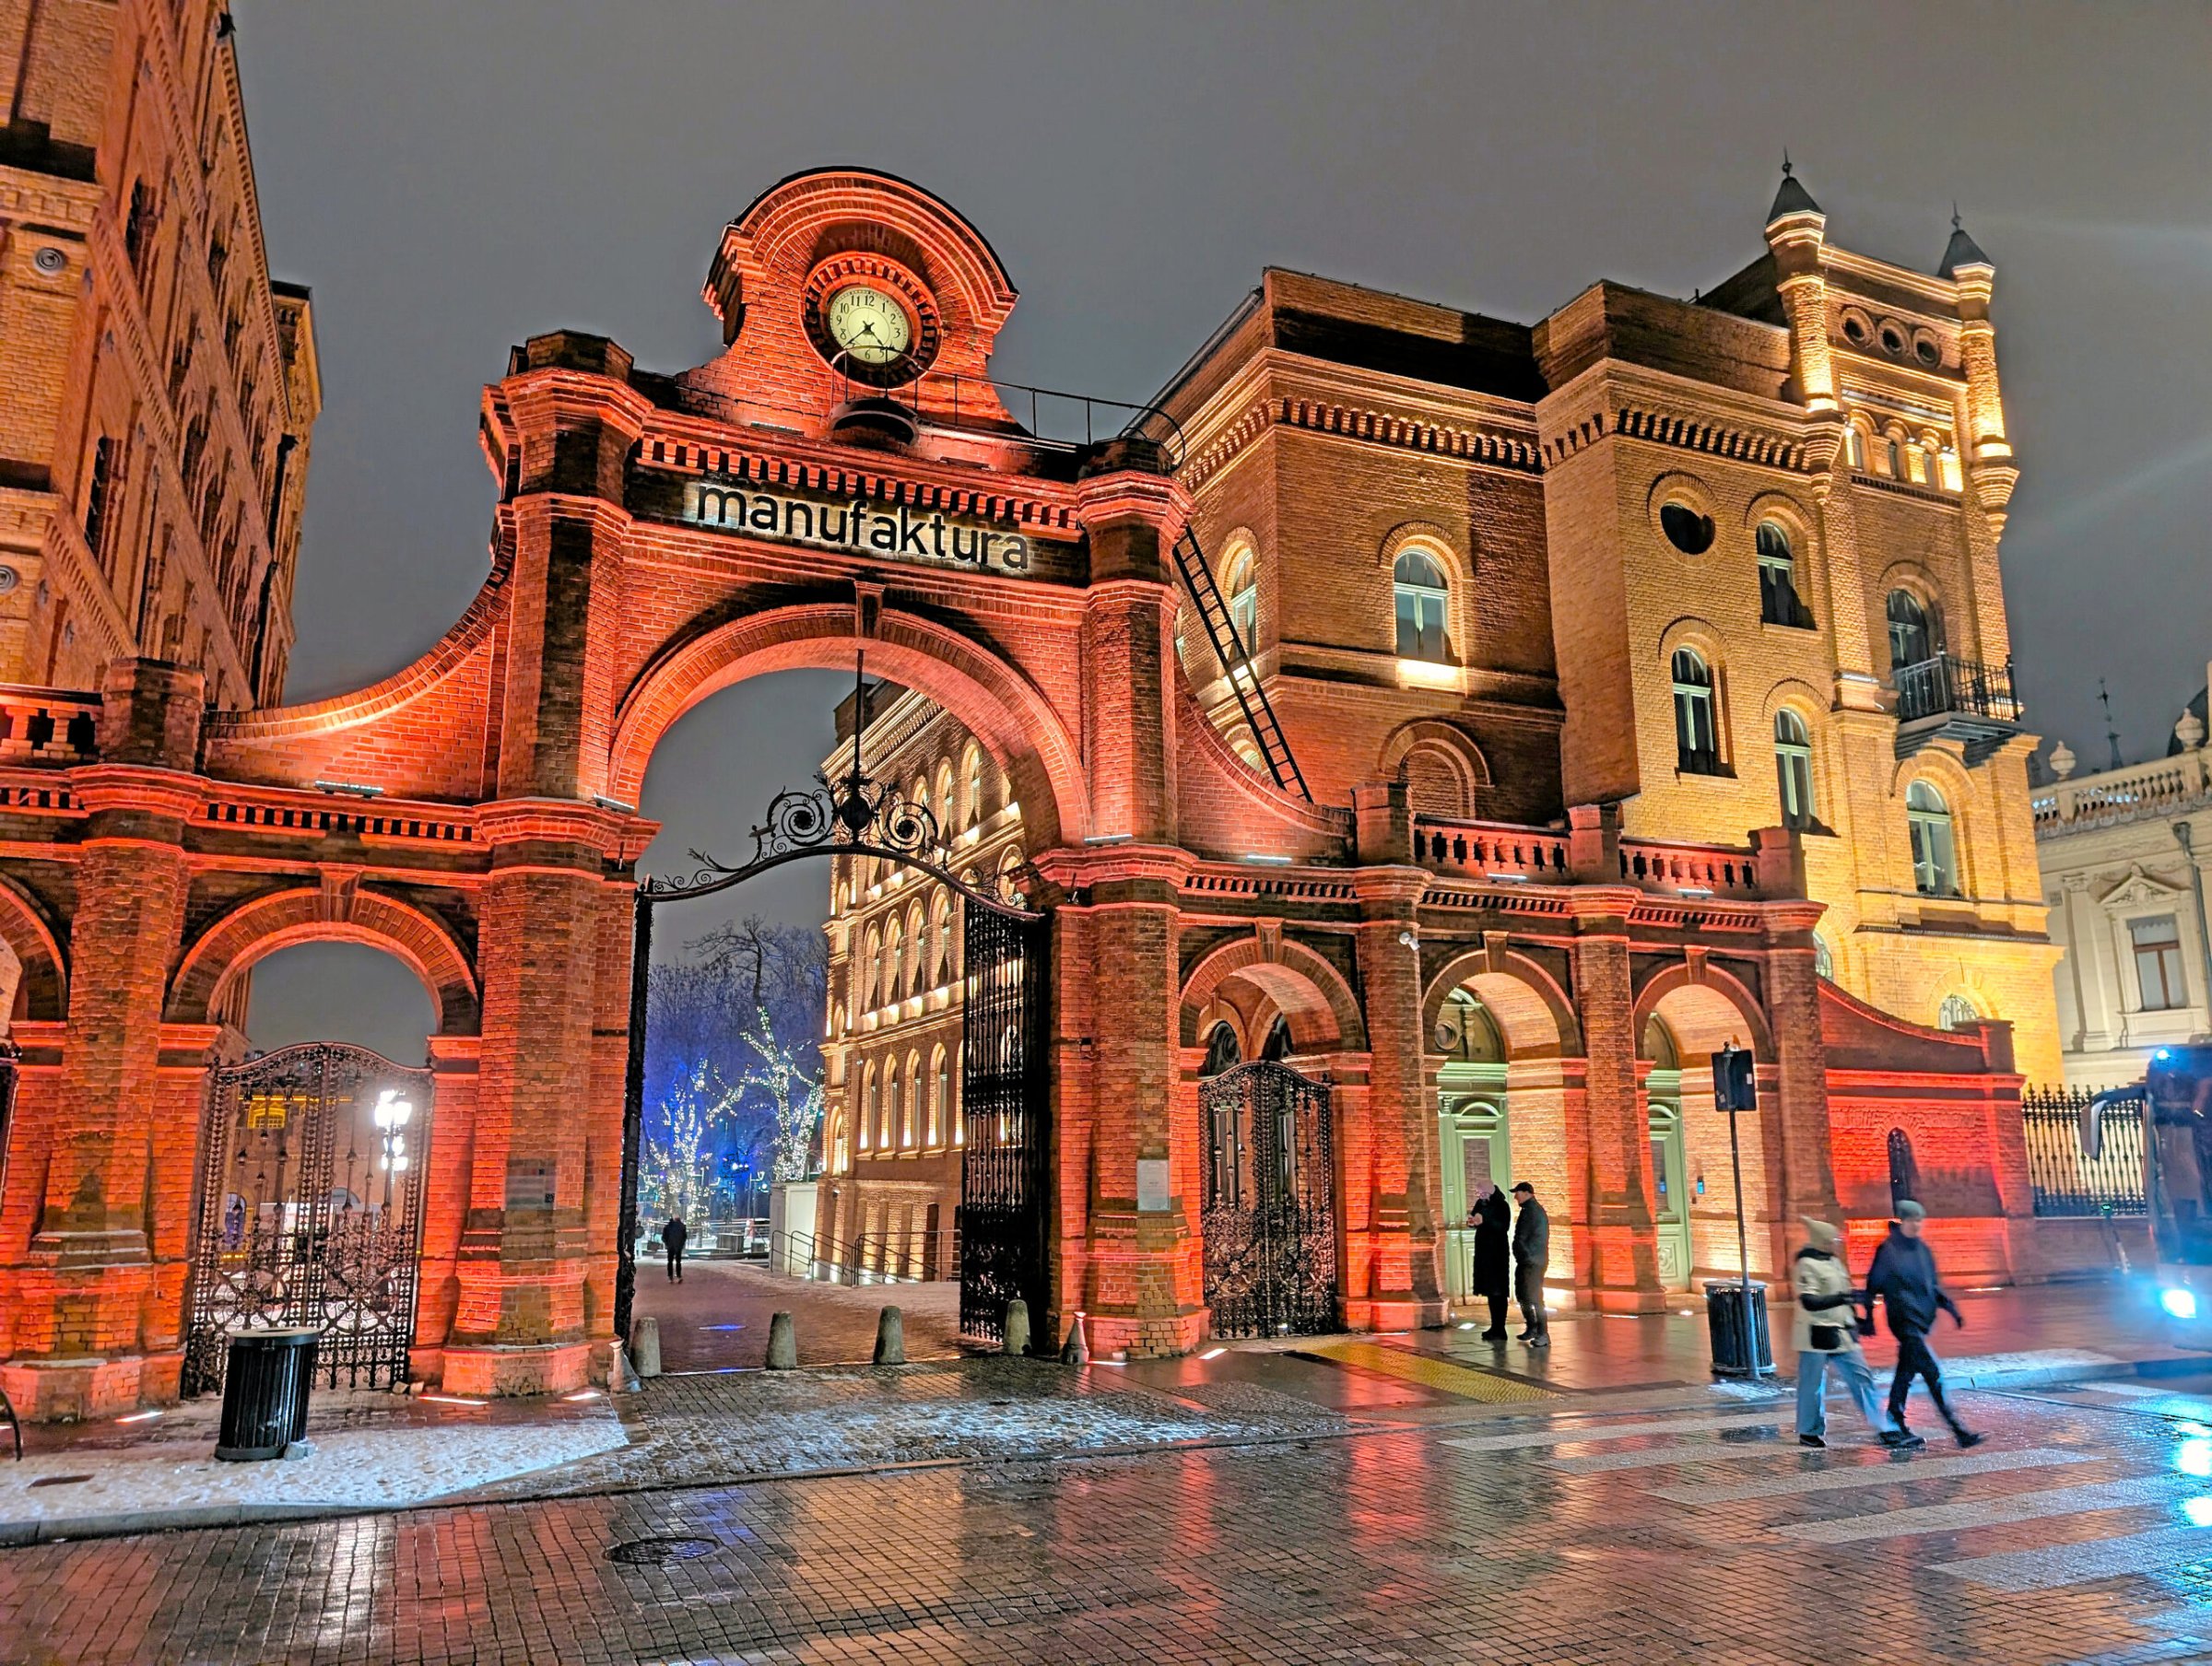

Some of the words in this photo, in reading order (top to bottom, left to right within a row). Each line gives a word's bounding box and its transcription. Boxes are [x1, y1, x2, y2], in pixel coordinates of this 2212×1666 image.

[851, 295, 860, 307] 11
[865, 295, 875, 307] 12
[840, 302, 850, 314] 10
[836, 315, 842, 325] 9
[890, 313, 897, 325] 2
[840, 328, 846, 340] 8
[893, 328, 900, 338] 3
[865, 349, 870, 359] 6
[697, 485, 1029, 569] manufaktura
